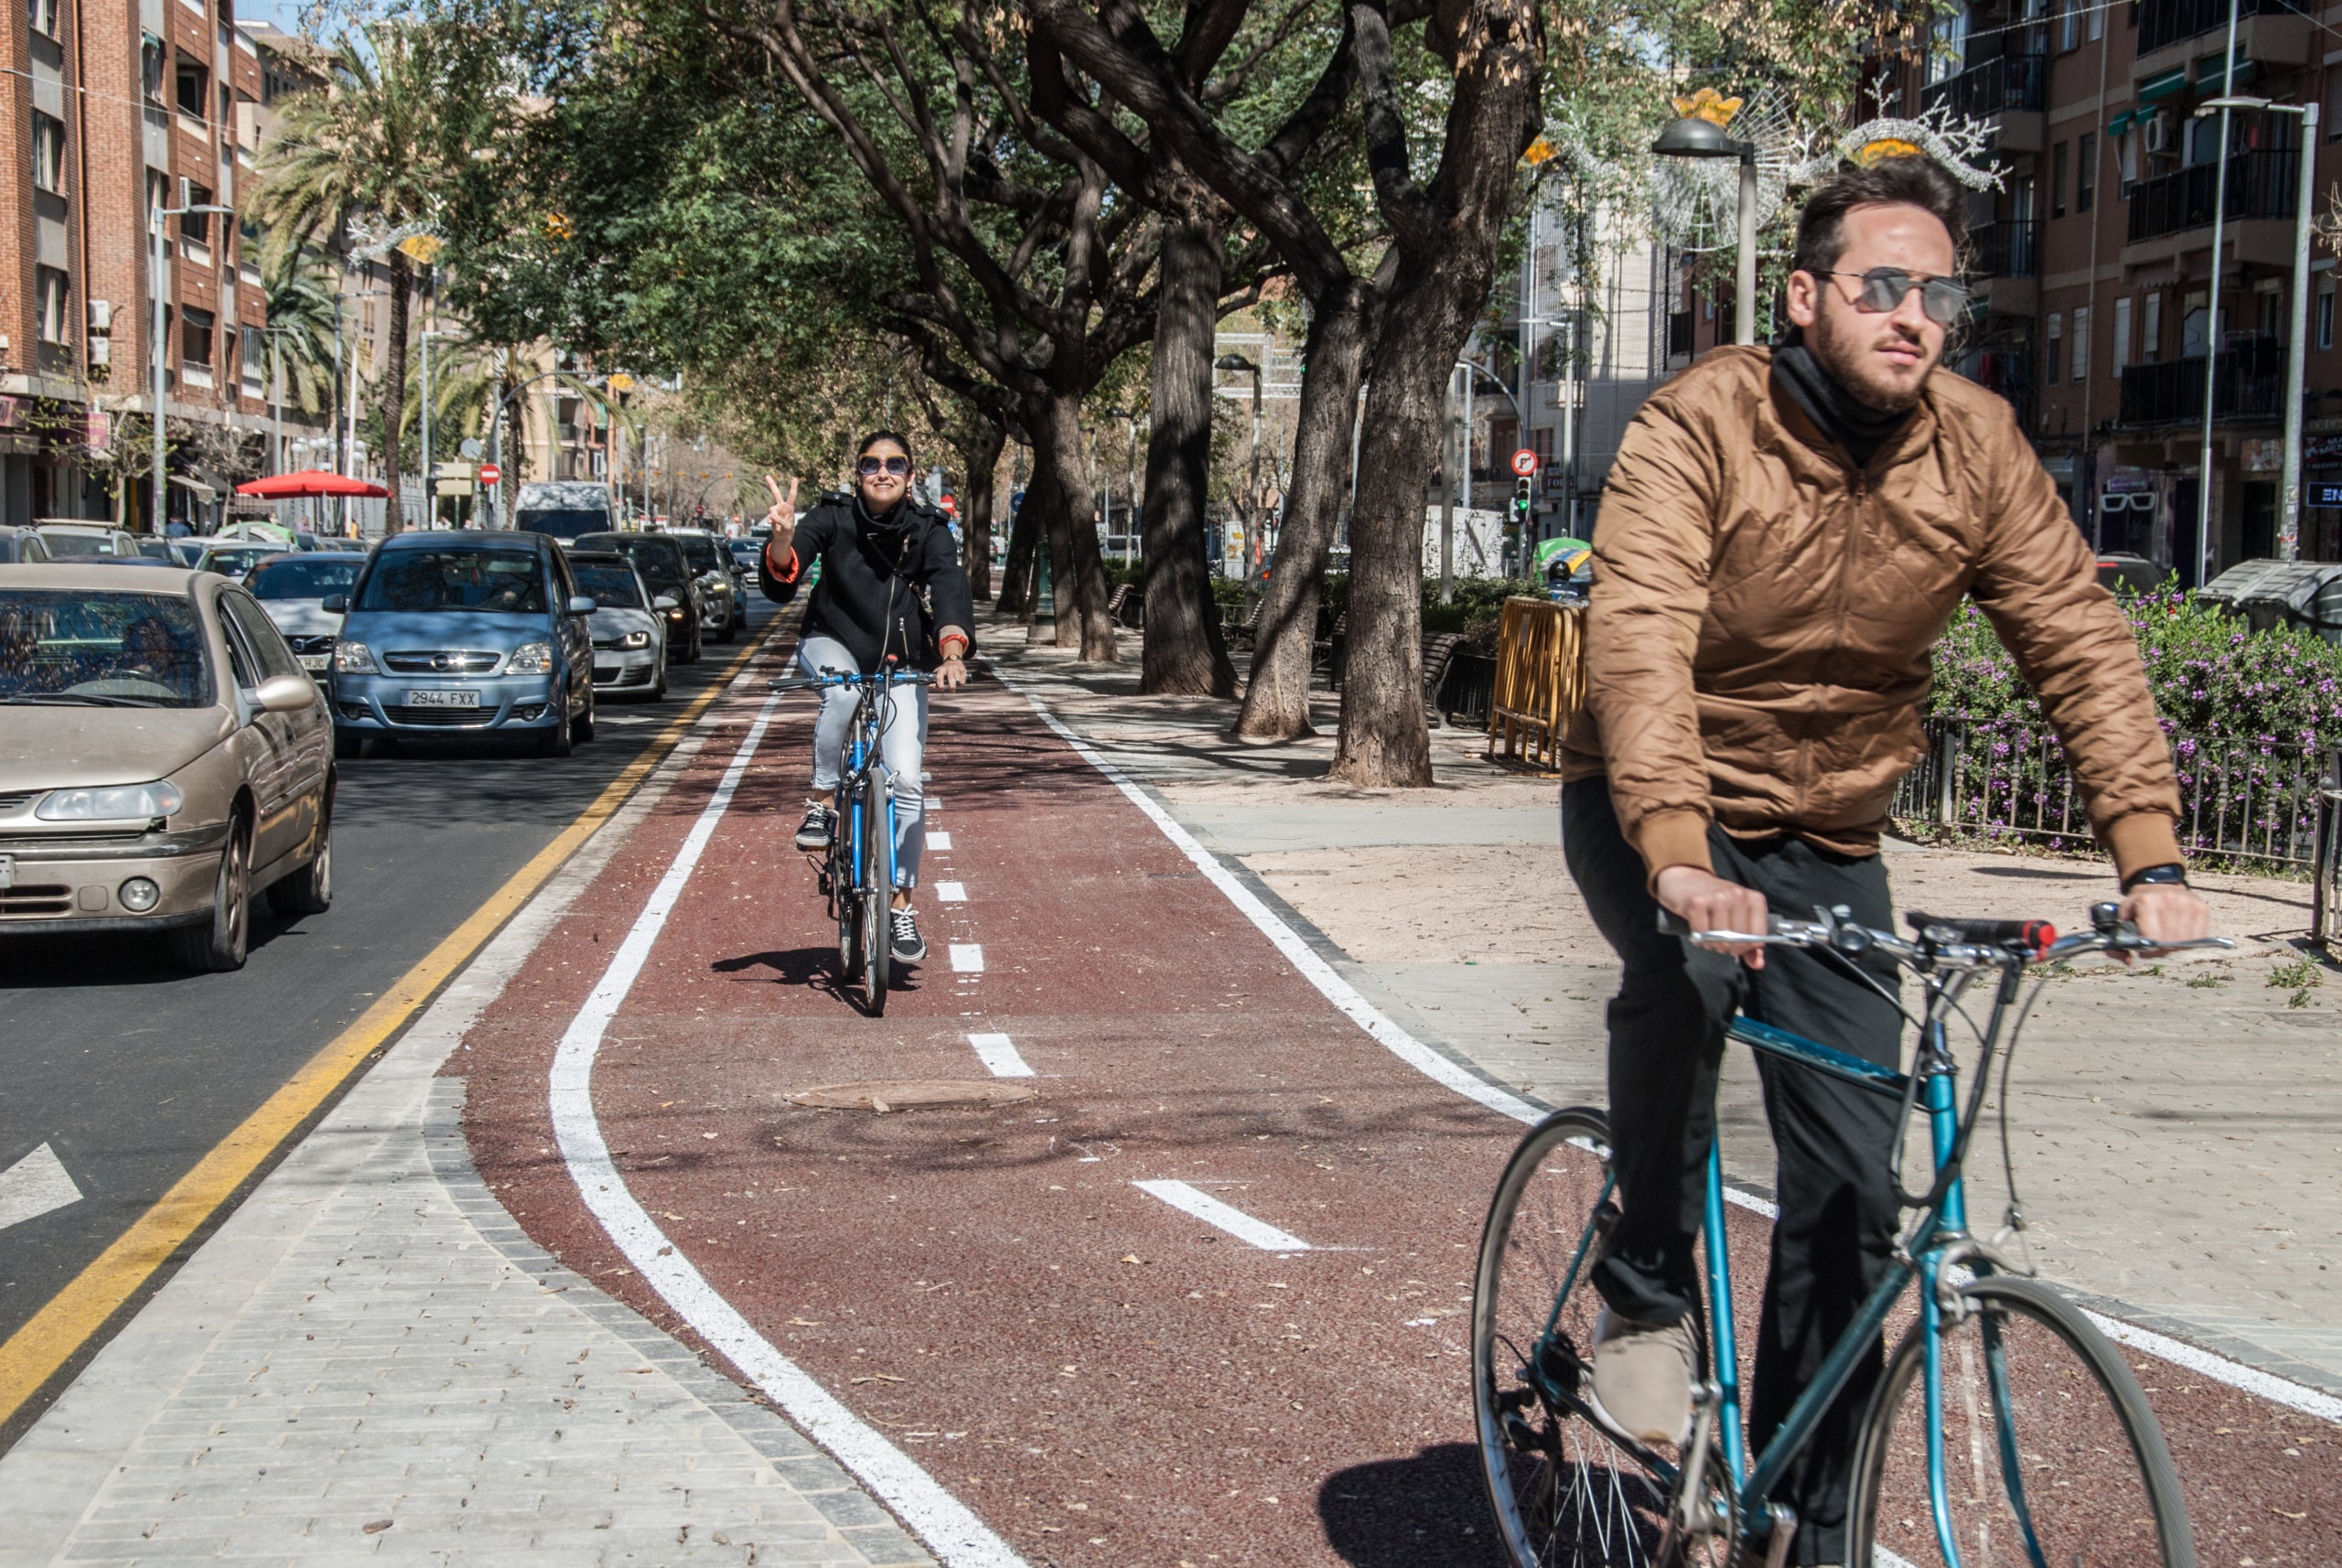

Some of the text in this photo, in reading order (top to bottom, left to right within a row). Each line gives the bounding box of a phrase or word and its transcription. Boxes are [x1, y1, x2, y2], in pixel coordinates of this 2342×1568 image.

[305, 658, 324, 668] HJC
[412, 692, 475, 705] 2944 FXX
